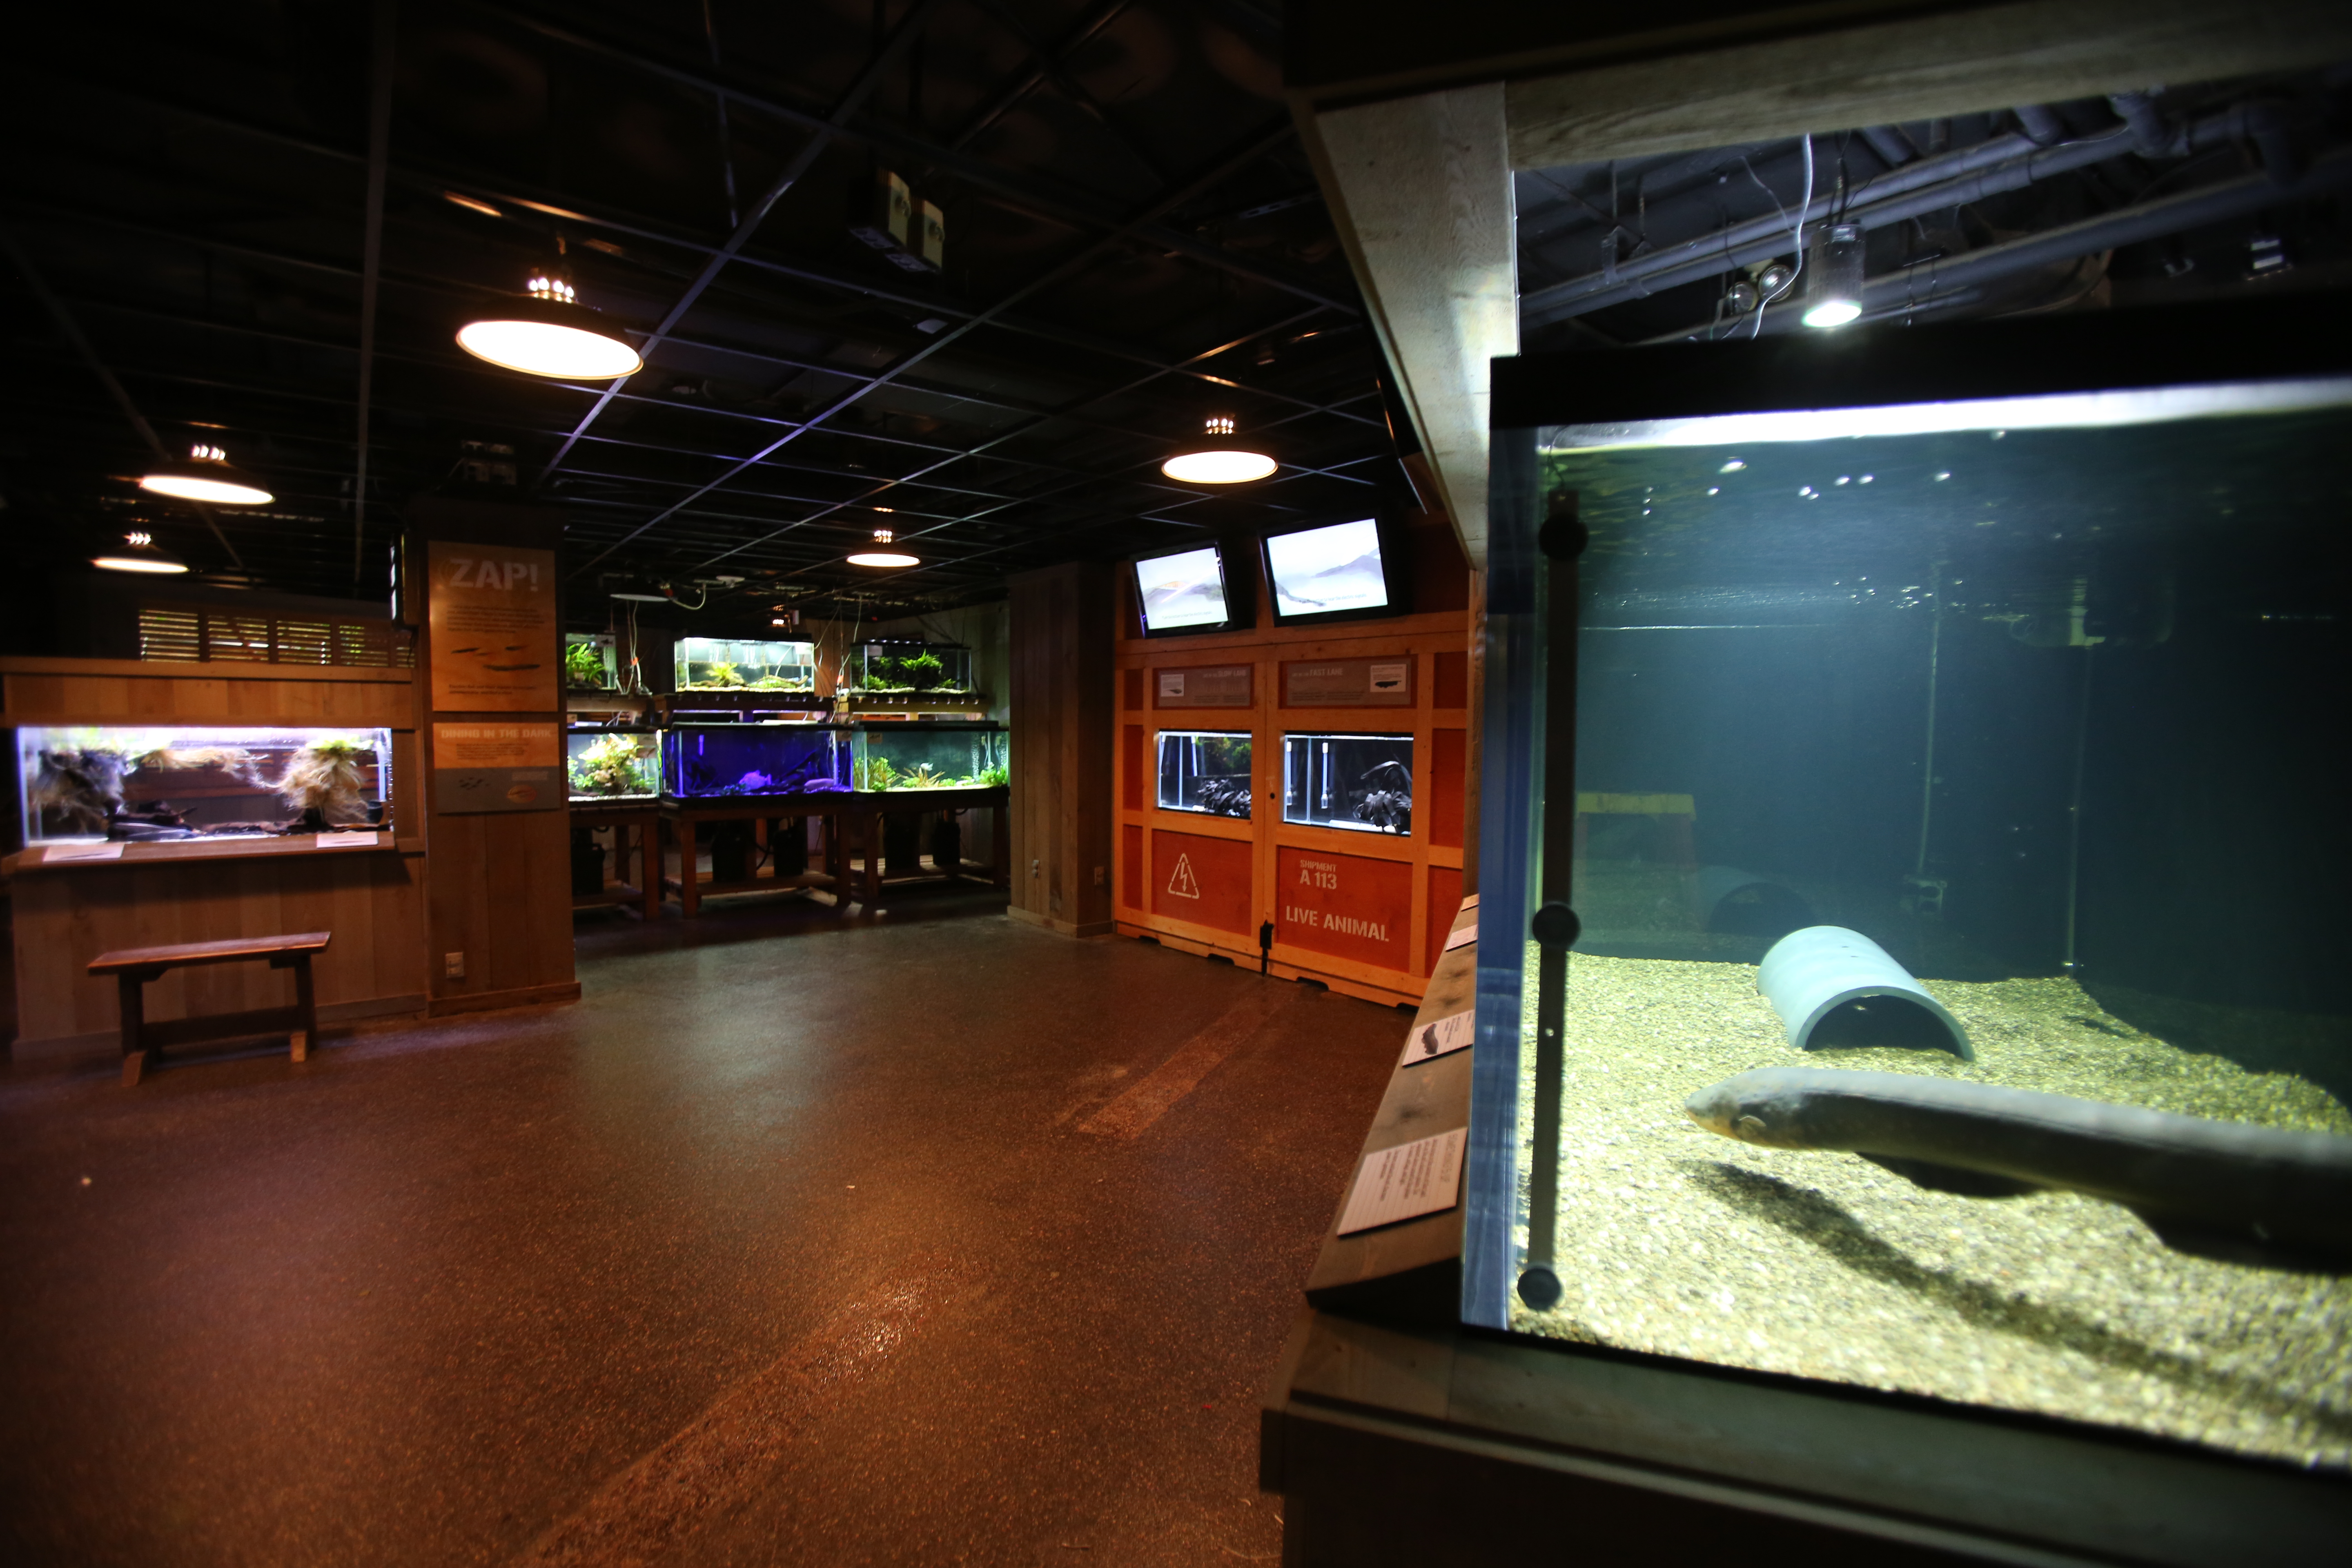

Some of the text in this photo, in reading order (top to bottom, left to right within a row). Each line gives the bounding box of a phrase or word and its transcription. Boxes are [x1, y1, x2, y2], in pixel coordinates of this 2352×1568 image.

[449, 558, 539, 592] ZAP!
[1310, 668, 1325, 677] FAST
[441, 729, 551, 738] DINING IN THE DARK
[1300, 860, 1337, 872] SHIPMENT
[1300, 869, 1337, 889] A 113
[1287, 905, 1390, 942] LIVE ANIMAL
